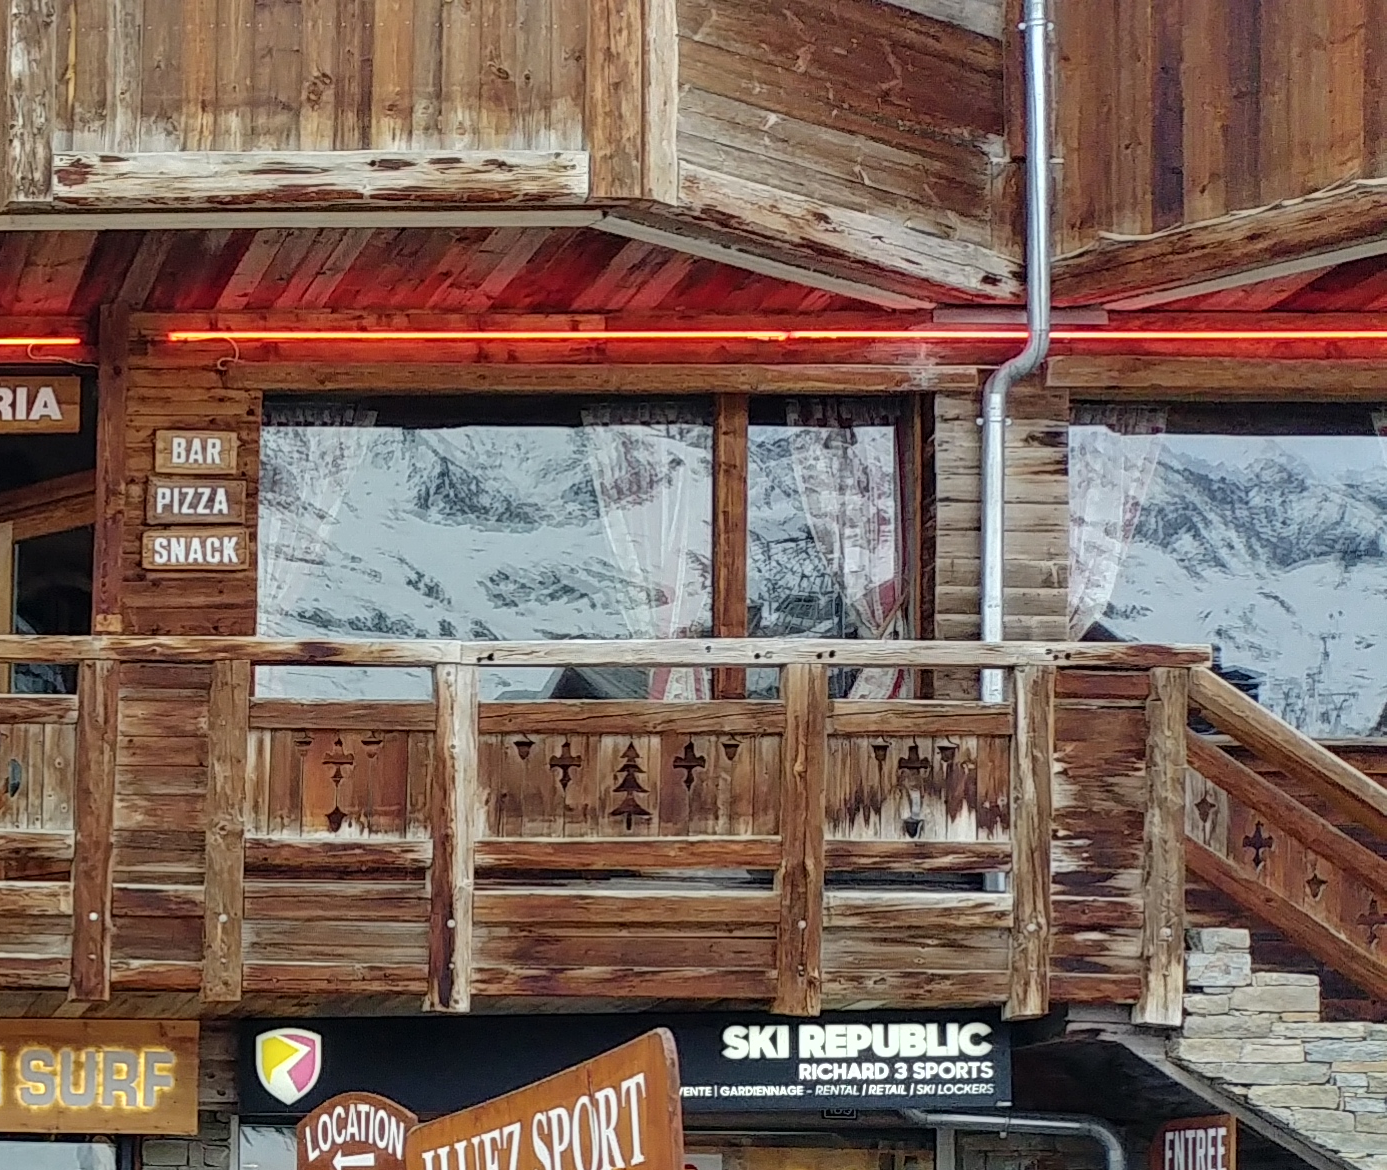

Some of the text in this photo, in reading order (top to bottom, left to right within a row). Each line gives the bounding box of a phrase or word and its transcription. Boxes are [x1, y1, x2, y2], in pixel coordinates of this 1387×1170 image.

[171, 436, 222, 467] BAR
[155, 486, 229, 516] PIZZA
[153, 534, 240, 567] SNACK
[721, 1022, 993, 1060] SKI REPUBLIC
[18, 1049, 175, 1108] SURF
[798, 1061, 994, 1081] RICHARD 3 SPORTS
[720, 1085, 804, 1097] GARDIENNAGE
[814, 1084, 860, 1096] RENTAL
[868, 1083, 908, 1095] RETAIL
[915, 1083, 936, 1095] SKI
[937, 1083, 994, 1095] LOCKERS
[304, 1103, 405, 1163] LOCATION
